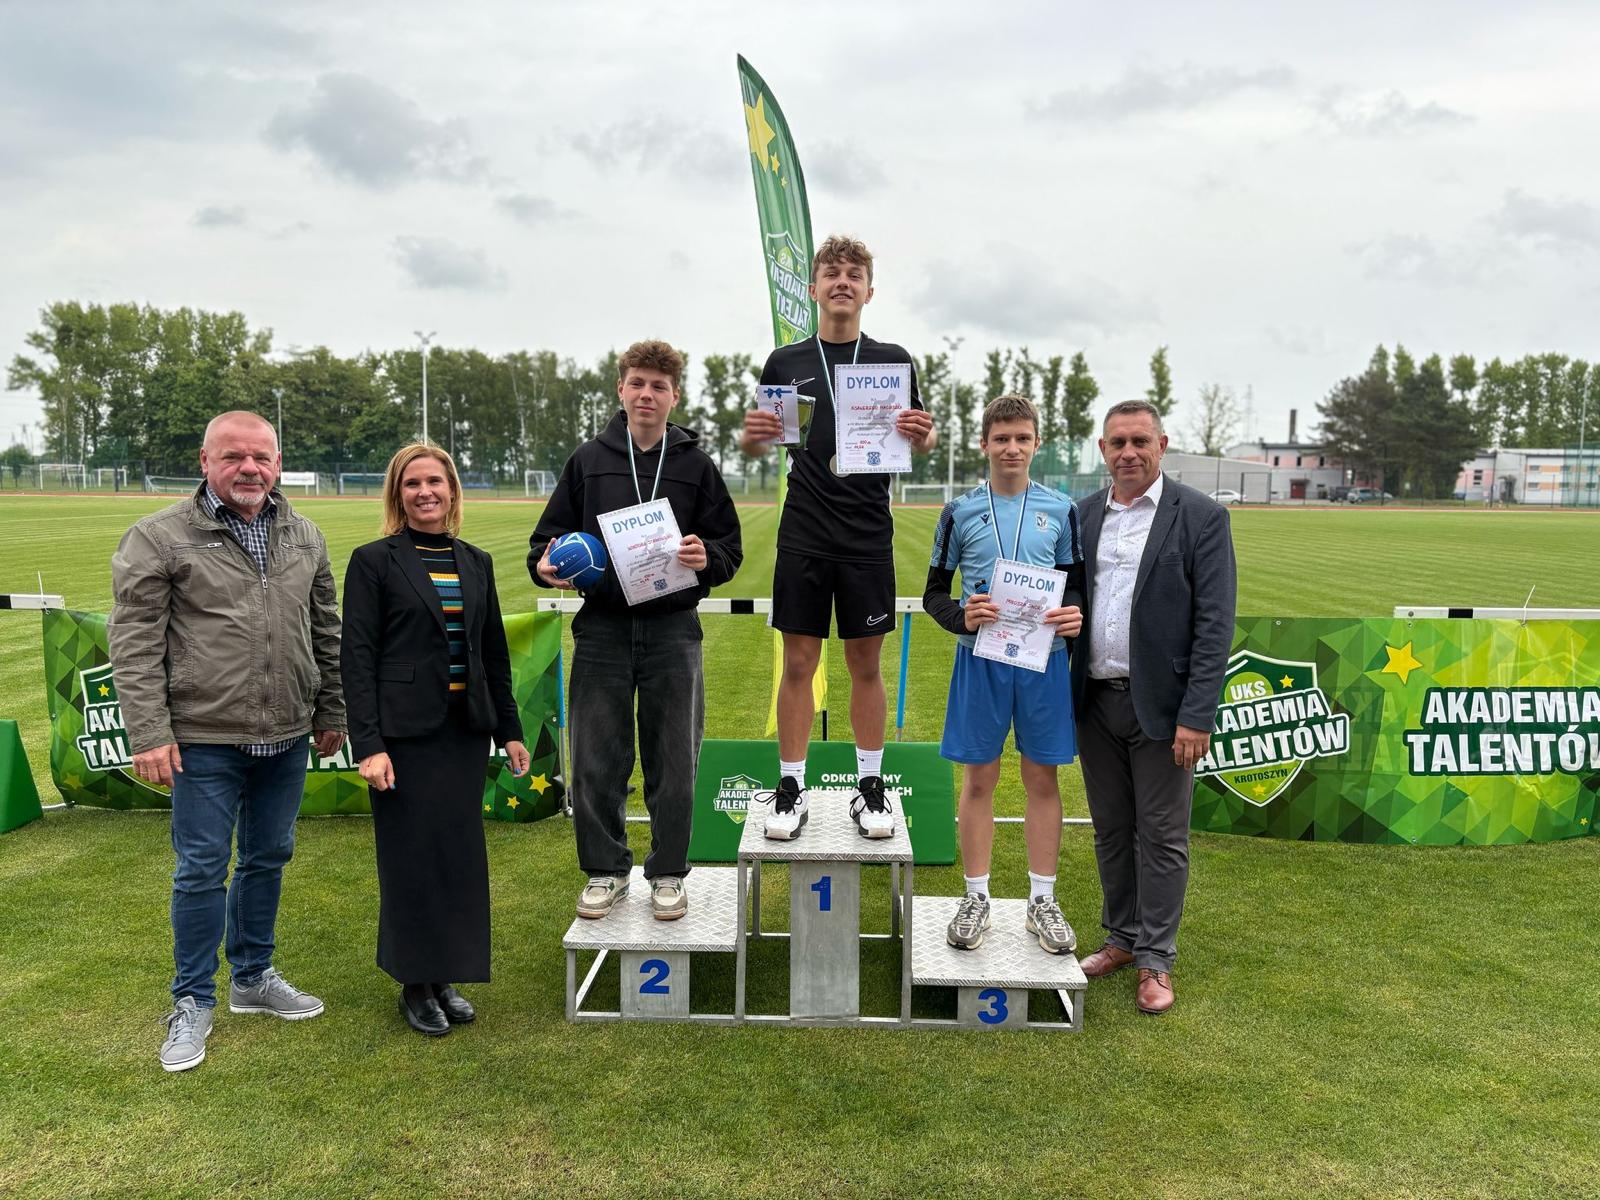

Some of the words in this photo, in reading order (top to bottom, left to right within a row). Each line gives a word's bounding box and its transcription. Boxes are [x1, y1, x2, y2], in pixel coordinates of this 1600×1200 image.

[847, 376, 900, 389] DYPLOM
[612, 510, 665, 534] DYPLOM
[1003, 571, 1056, 593] DYPLOM
[1230, 680, 1267, 701] UKS
[1215, 693, 1326, 735] ADEMIA
[1425, 691, 1600, 723] AKADEMIA
[1196, 720, 1344, 772] ALENTÓW
[1234, 768, 1289, 784] KROTOSZYN
[715, 799, 751, 810] TALENT
[811, 875, 831, 912] 1
[639, 959, 670, 995] 2
[977, 988, 1008, 1025] 3
